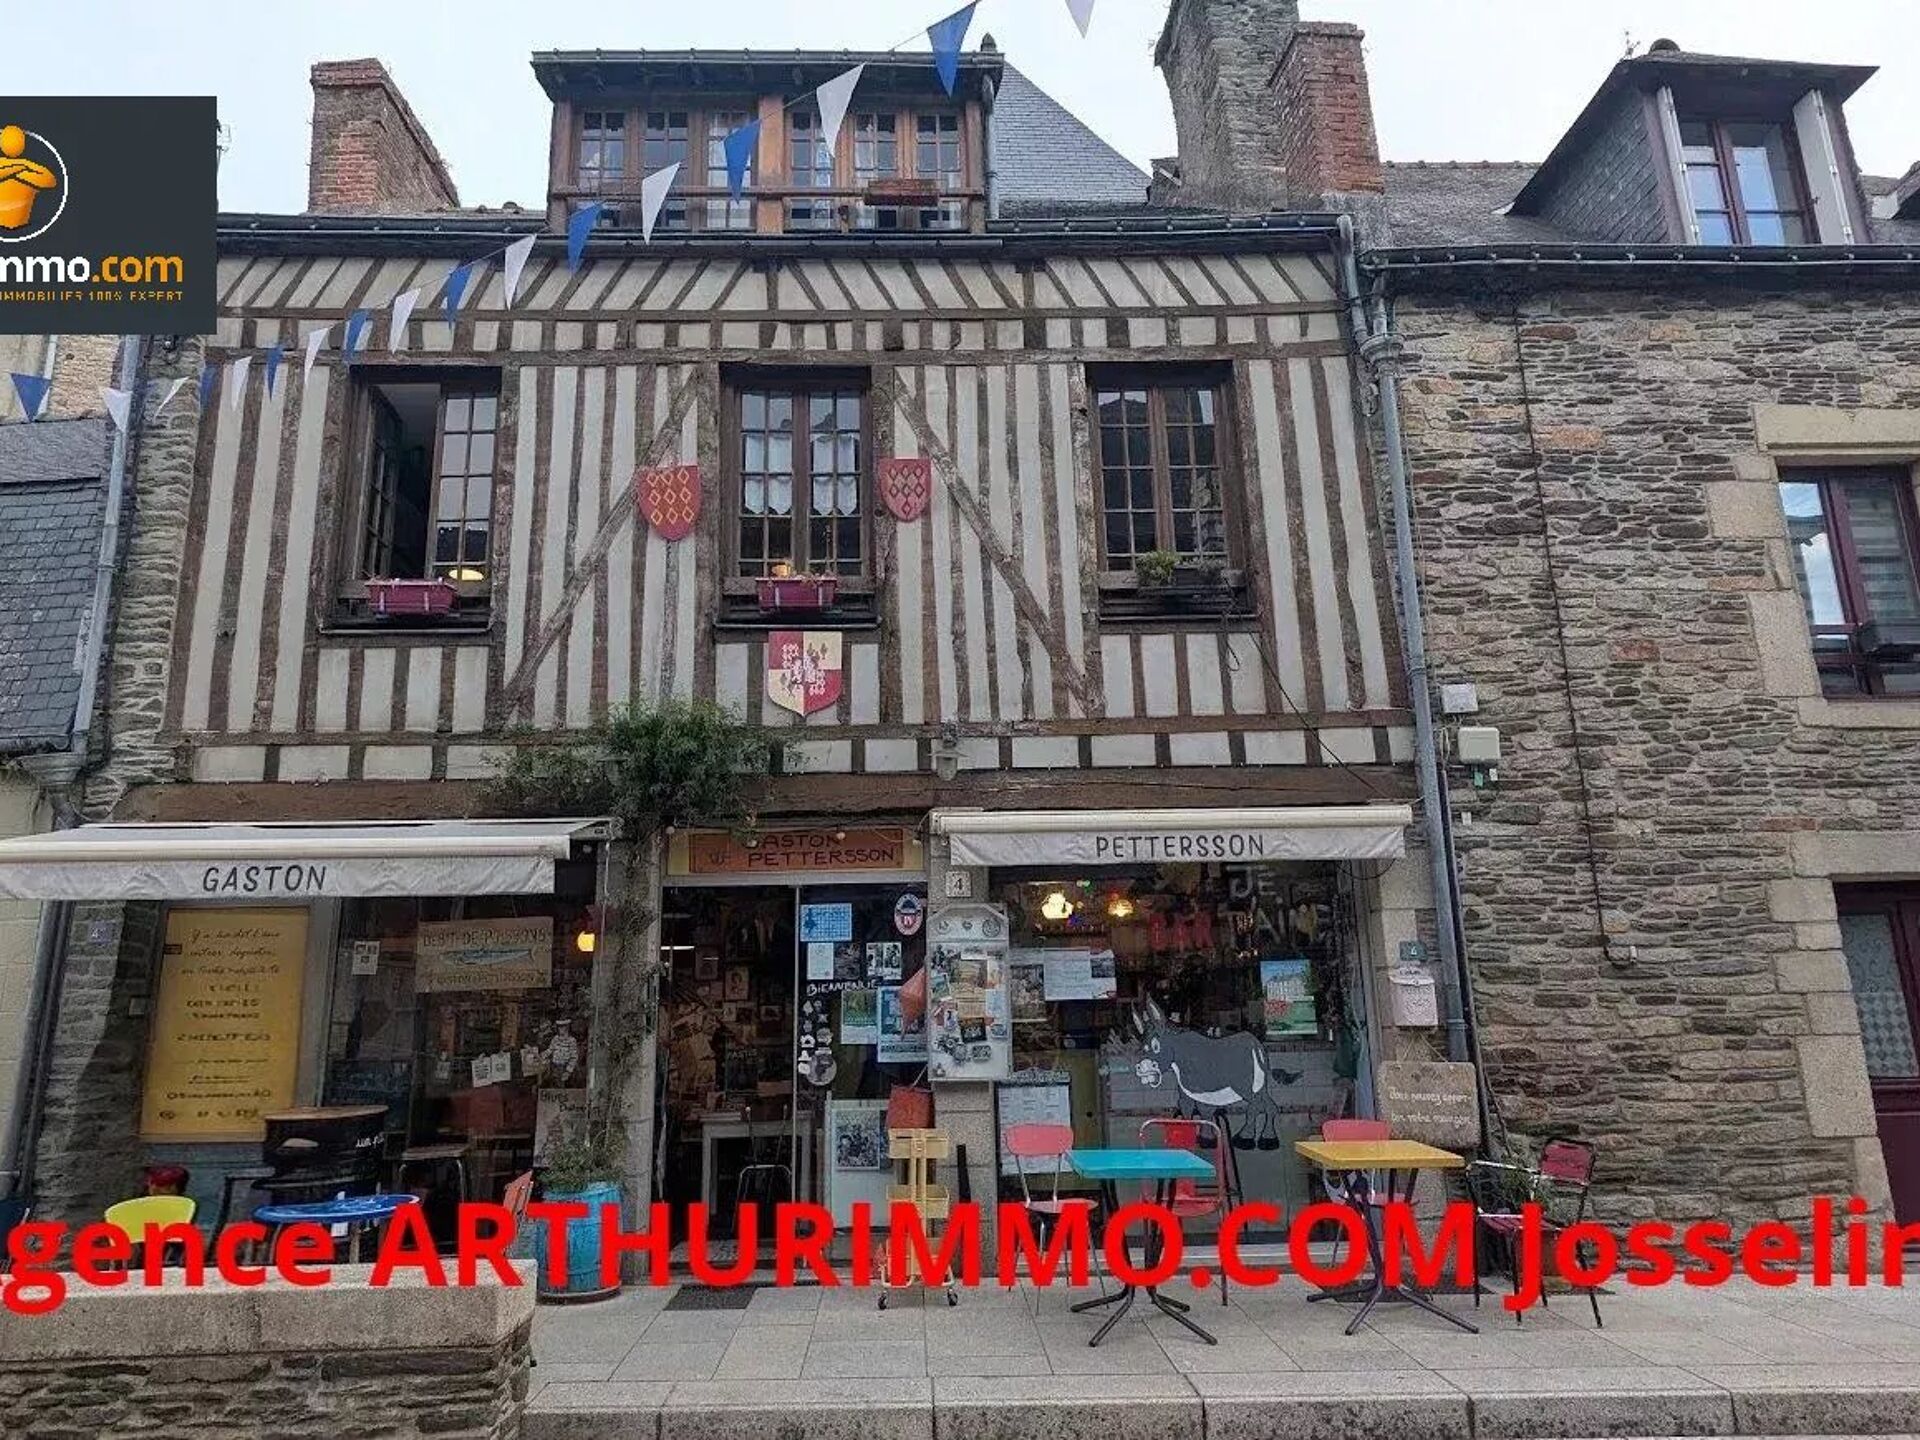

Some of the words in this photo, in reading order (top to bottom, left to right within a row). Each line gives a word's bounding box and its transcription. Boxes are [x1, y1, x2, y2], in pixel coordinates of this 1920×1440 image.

[748, 848, 895, 868] PETTERSSON
[1096, 833, 1264, 858] PETTERSSON
[202, 864, 327, 892] GASTON
